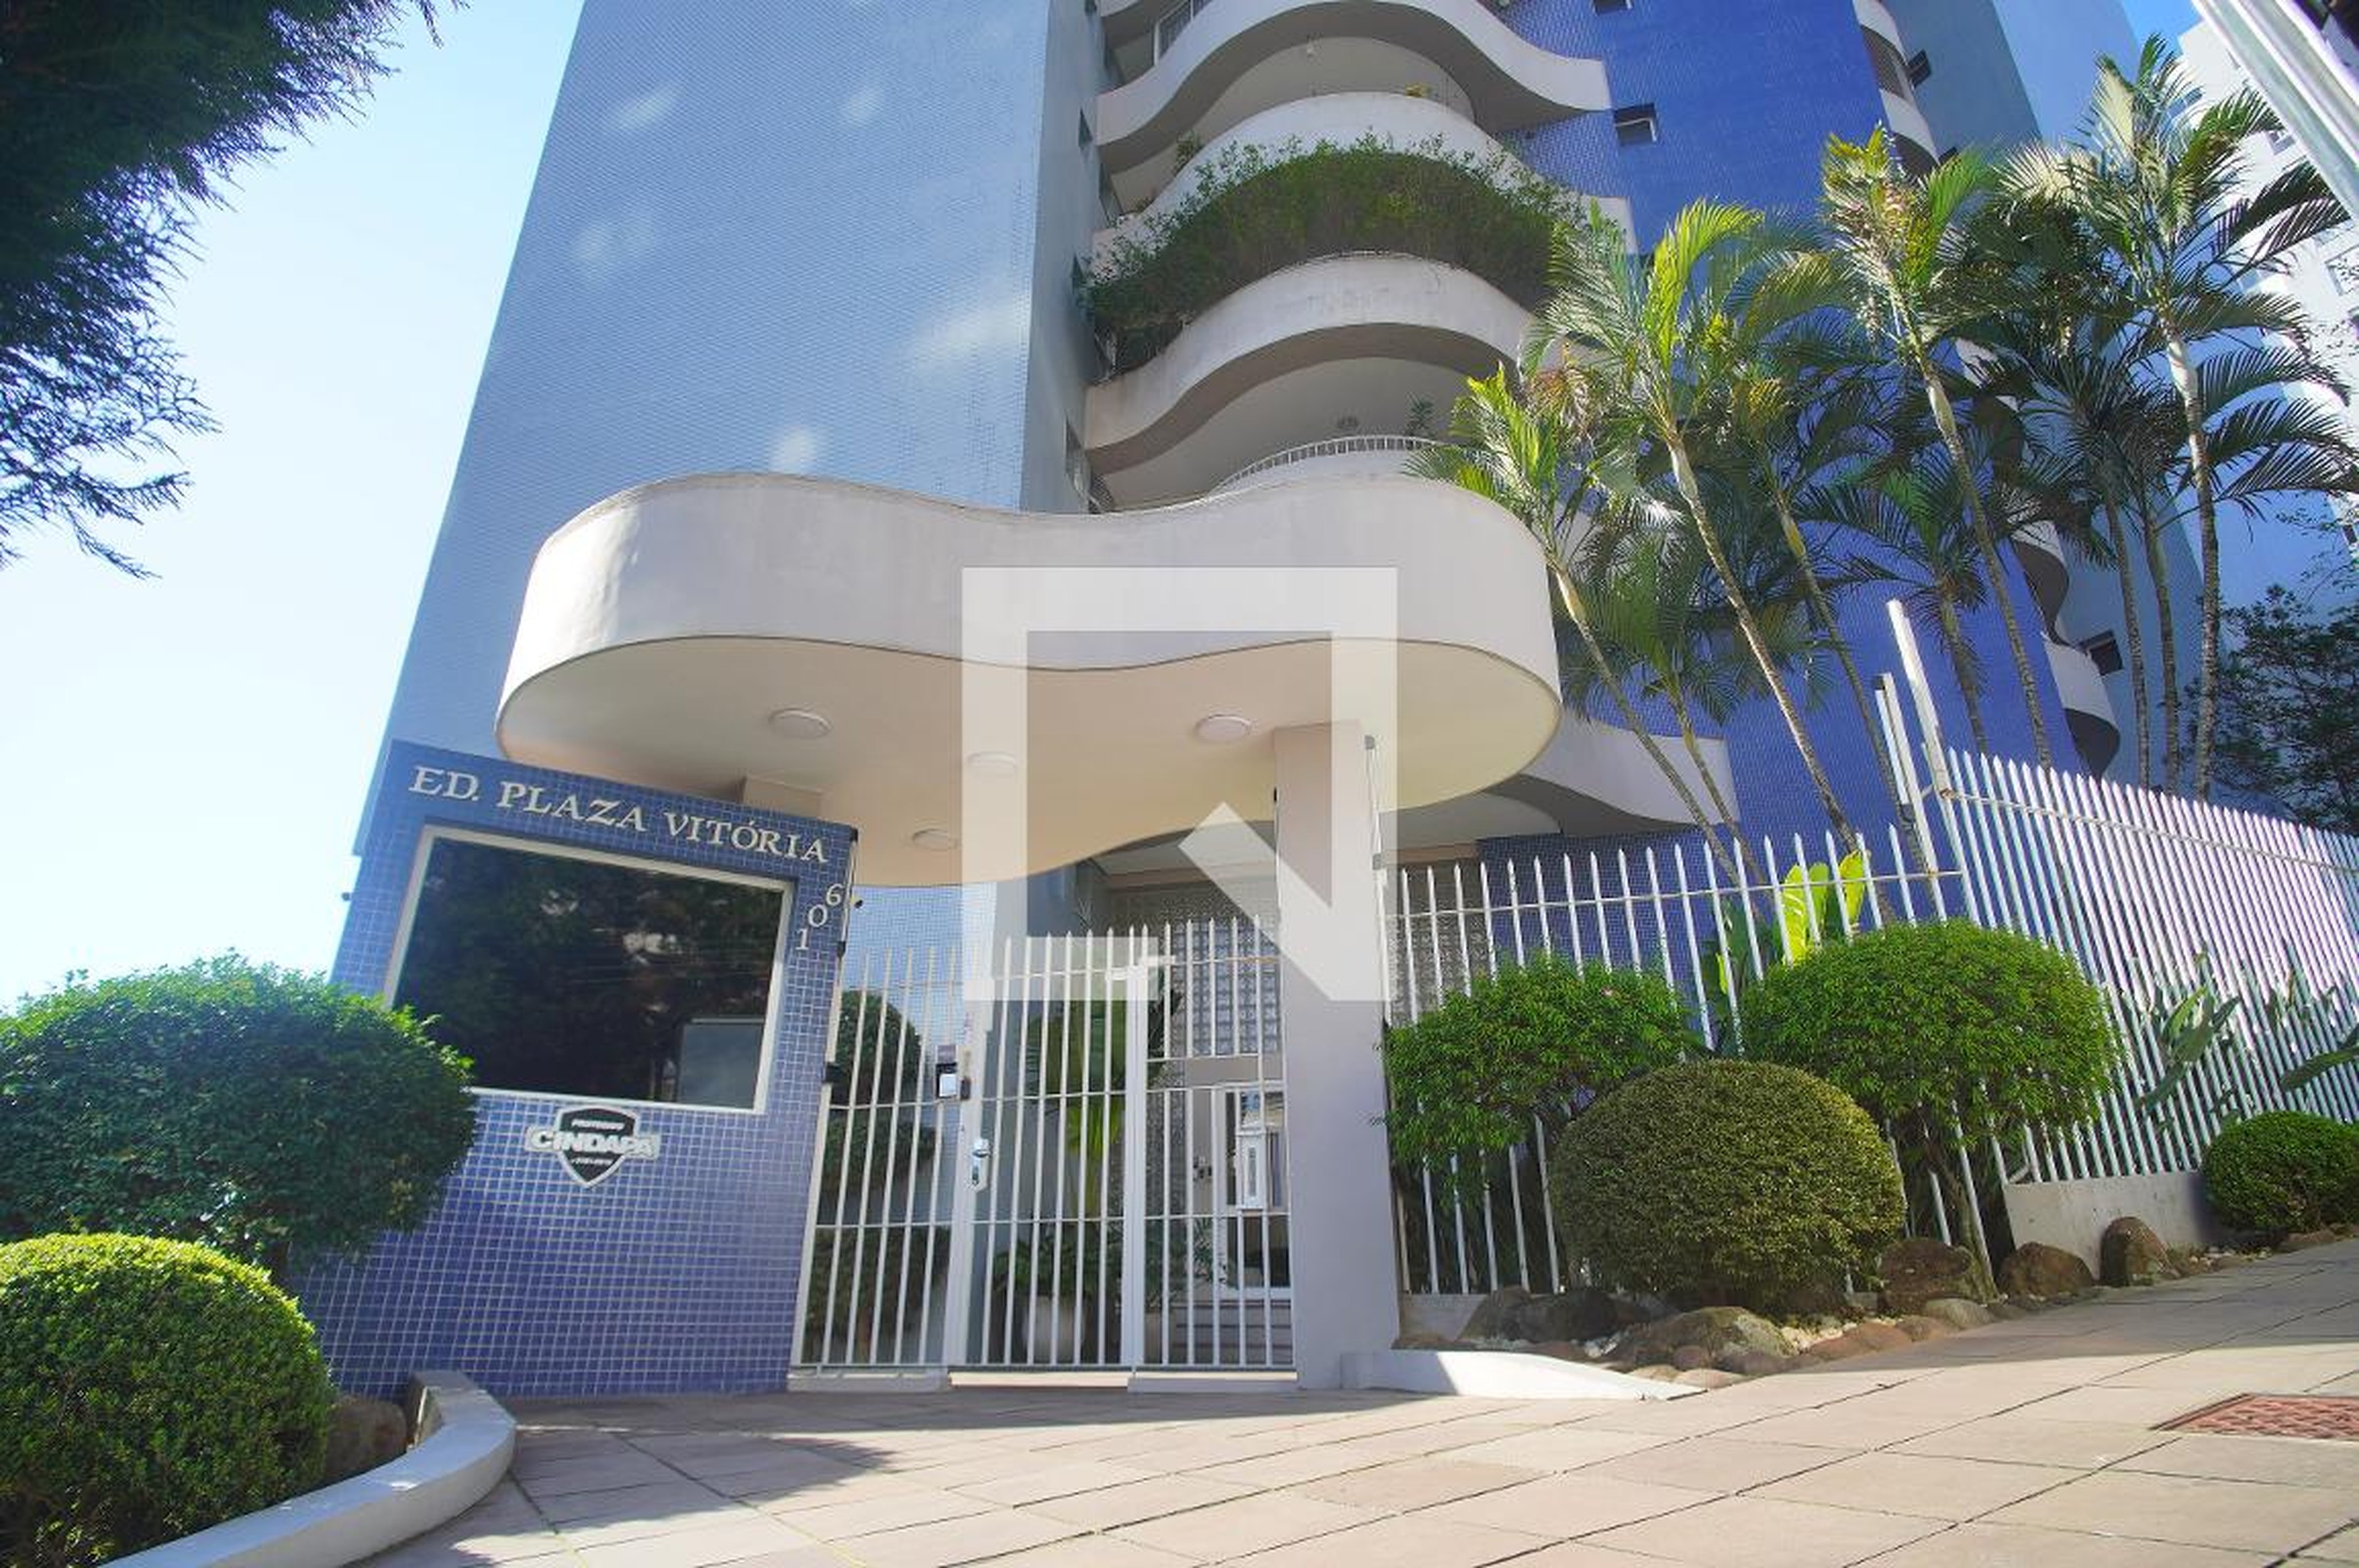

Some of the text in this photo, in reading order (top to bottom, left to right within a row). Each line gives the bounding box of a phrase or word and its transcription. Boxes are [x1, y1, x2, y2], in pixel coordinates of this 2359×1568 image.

[409, 766, 829, 863] ED. PLAZA VITÓRIA
